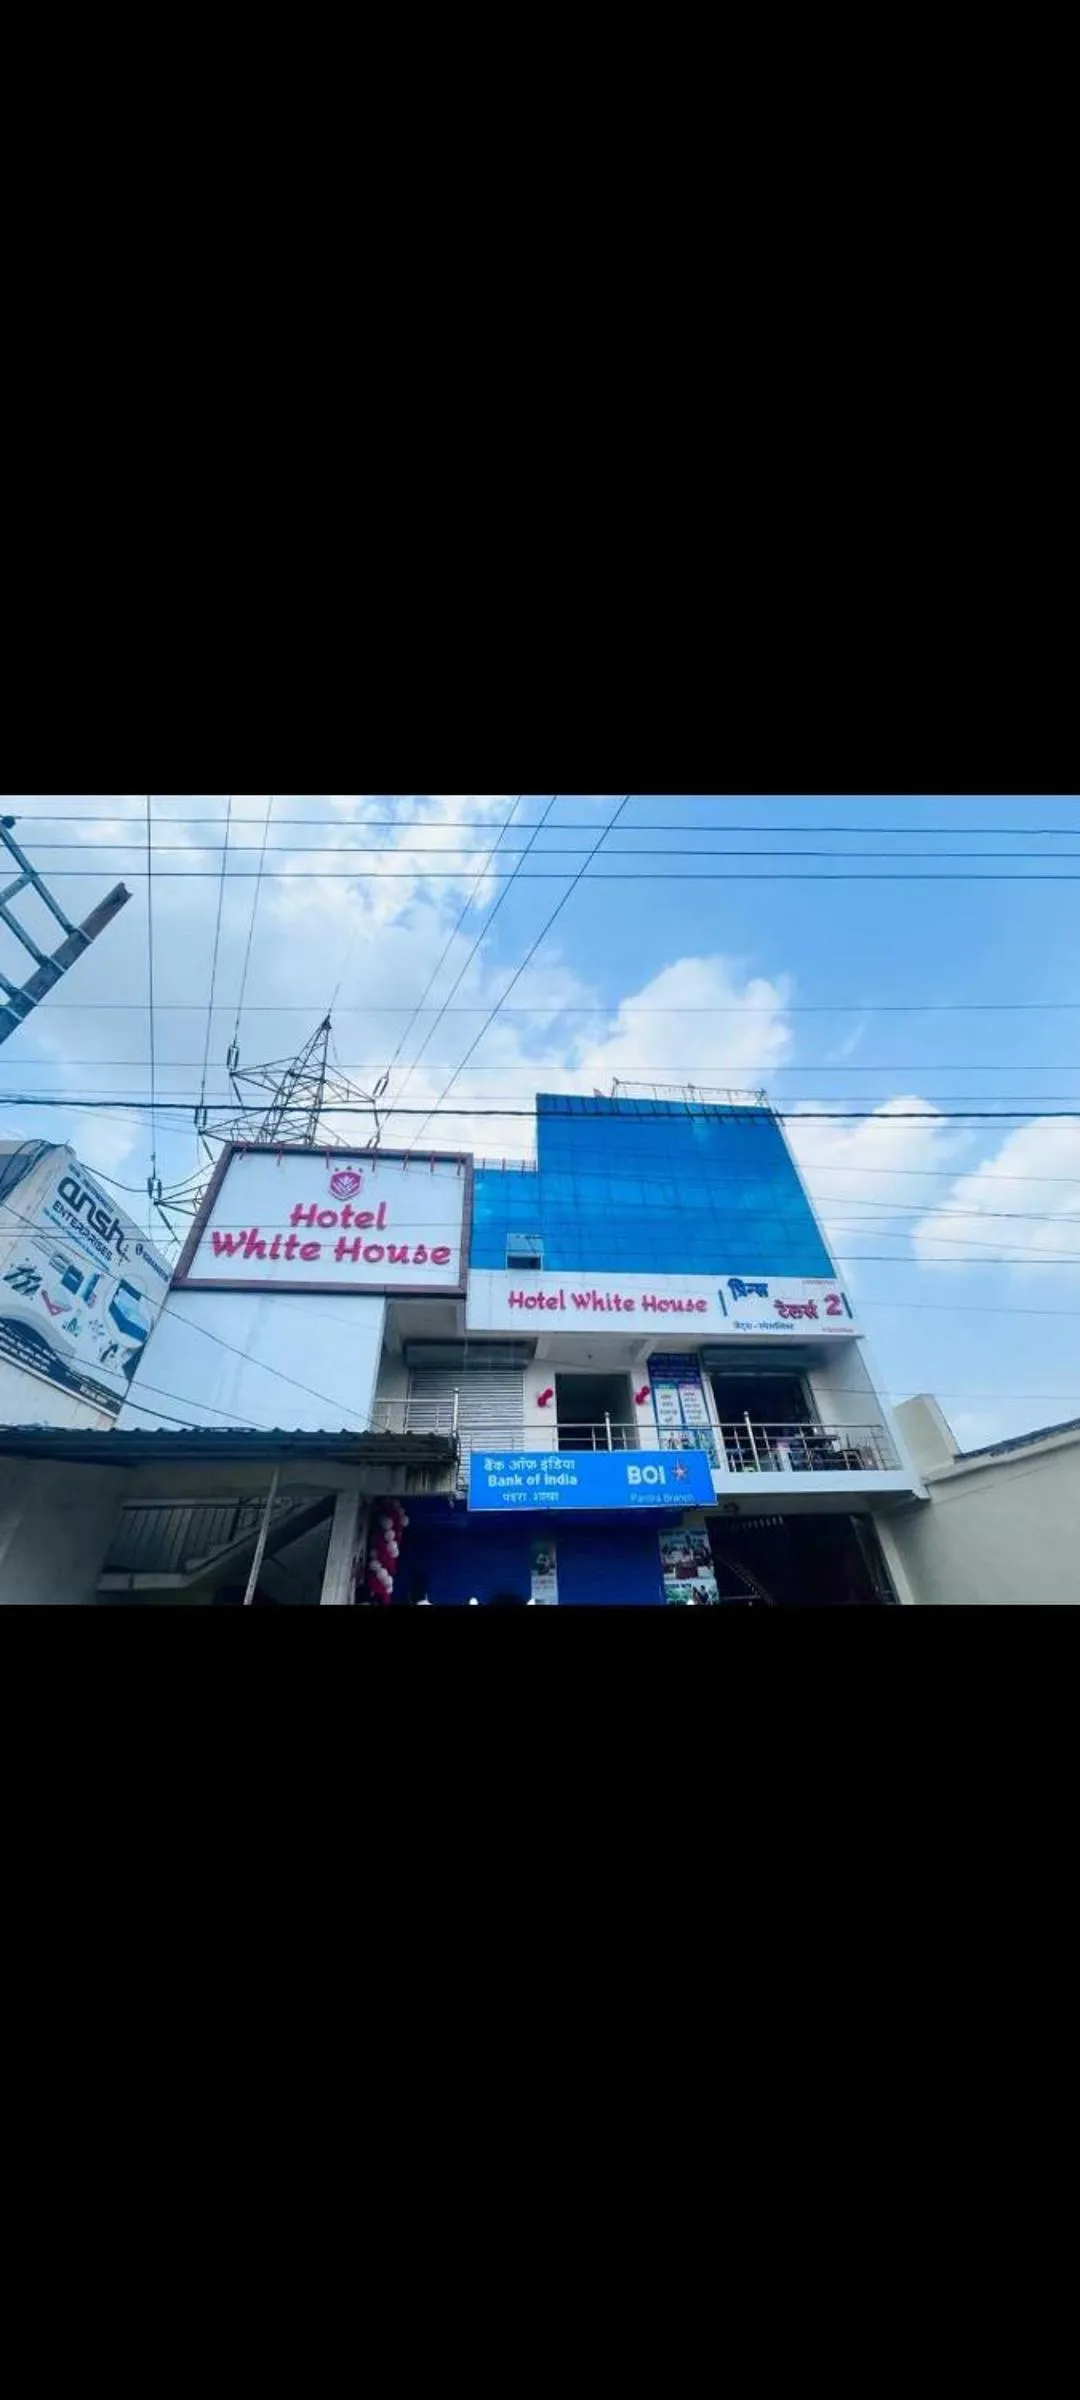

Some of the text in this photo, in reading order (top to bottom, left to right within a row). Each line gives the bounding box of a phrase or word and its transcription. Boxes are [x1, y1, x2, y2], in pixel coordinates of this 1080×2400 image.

[290, 1201, 387, 1231] Hotel
[52, 1200, 113, 1261] ENTERPRISES
[212, 1228, 452, 1265] White House
[508, 1289, 708, 1313] Hotel White House
[824, 1293, 843, 1316] 2
[483, 1457, 505, 1472] बैंक
[540, 1455, 576, 1471] इंडिया
[487, 1473, 578, 1487] Bank of India
[627, 1465, 667, 1486] BOI
